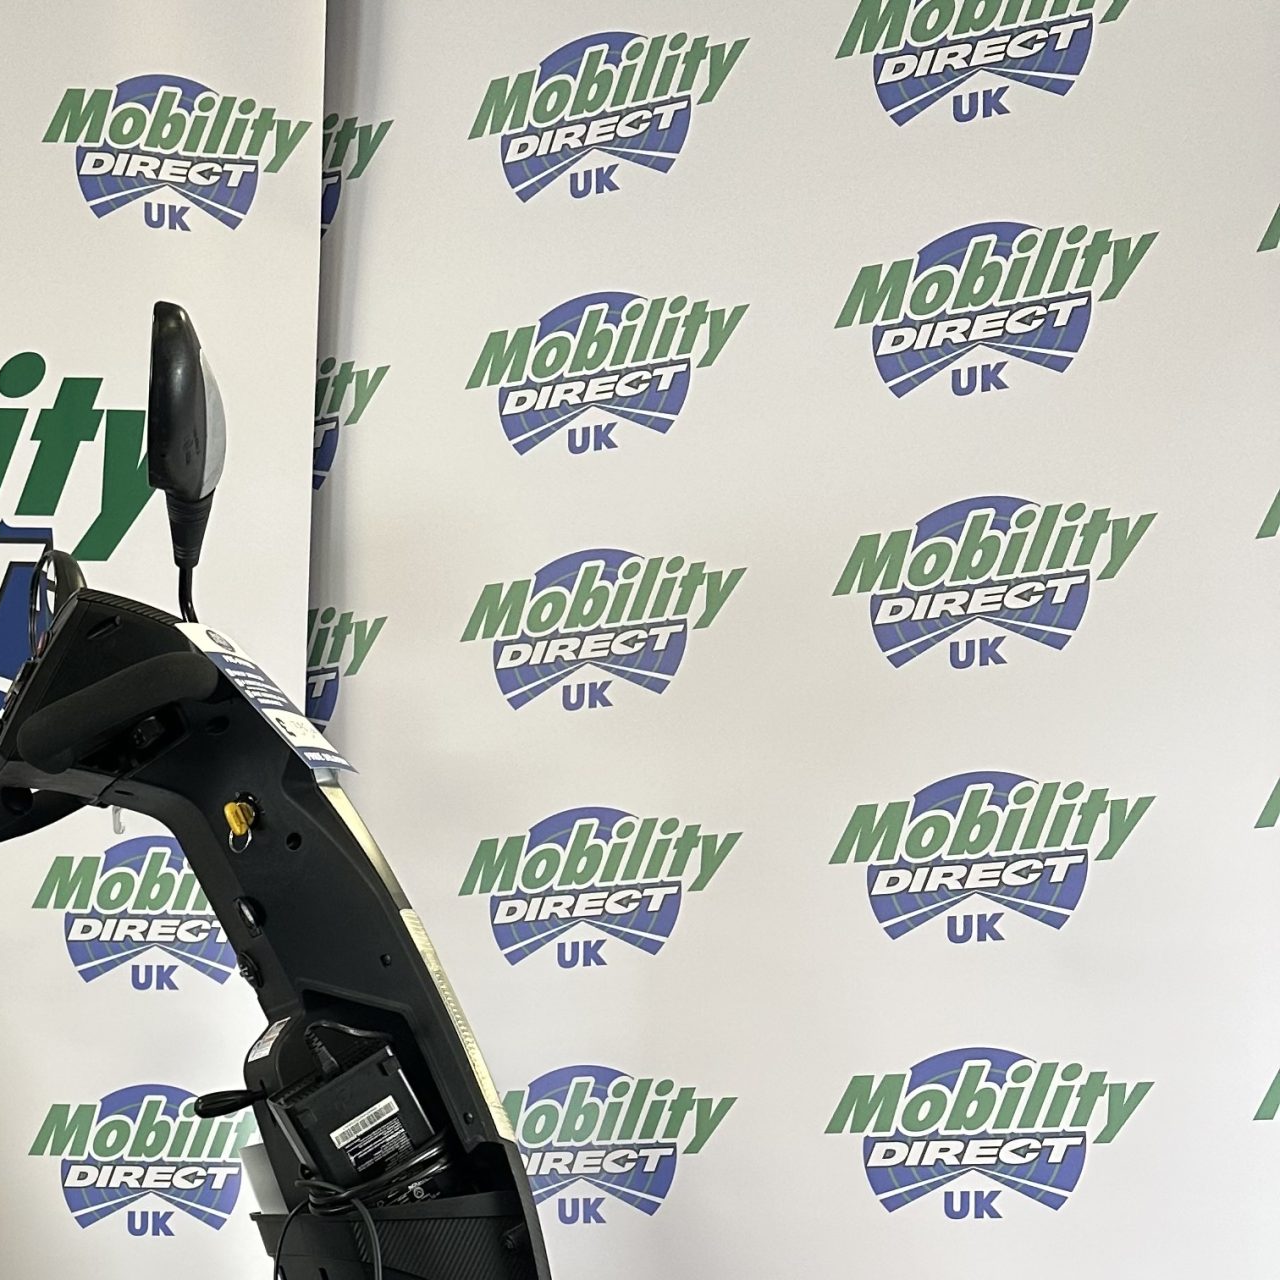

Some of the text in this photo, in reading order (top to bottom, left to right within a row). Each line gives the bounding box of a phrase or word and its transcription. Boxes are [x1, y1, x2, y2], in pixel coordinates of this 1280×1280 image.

[877, 19, 1090, 85] DIRECT
[467, 32, 750, 140] Mobility
[952, 85, 1011, 123] UK
[41, 88, 313, 173] Mobility
[504, 101, 688, 164] DIRECT
[79, 152, 256, 187] DIRECT
[570, 163, 621, 199] UK
[144, 201, 191, 232] UK
[833, 224, 1160, 329] Mobility
[465, 295, 750, 390] Mobility
[876, 297, 1089, 357] DIRECT
[501, 363, 688, 416] DIRECT
[951, 361, 1009, 397] UK
[568, 421, 618, 455] UK
[831, 502, 1158, 596] Mobility
[460, 556, 748, 642] Mobility
[873, 575, 1087, 626] DIRECT
[496, 624, 685, 670] DIRECT
[949, 635, 1008, 670] UK
[562, 680, 613, 711] UK
[828, 781, 1157, 865] Mobility
[458, 817, 743, 896] Mobility
[870, 854, 1085, 896] DIRECT
[32, 852, 209, 911] Mobi
[493, 886, 679, 925] DIRECT
[946, 912, 1005, 944] UK
[557, 939, 608, 969] UK
[131, 965, 179, 991] UK
[824, 1062, 1155, 1144] Mobility
[28, 1100, 257, 1159] Mobilit
[521, 1148, 674, 1176] IRECT
[866, 1137, 1084, 1168] DIRECT
[64, 1166, 240, 1190] DIRECT
[127, 1211, 175, 1237] UK
[557, 1197, 607, 1225] UK
[943, 1190, 1003, 1220] UK
